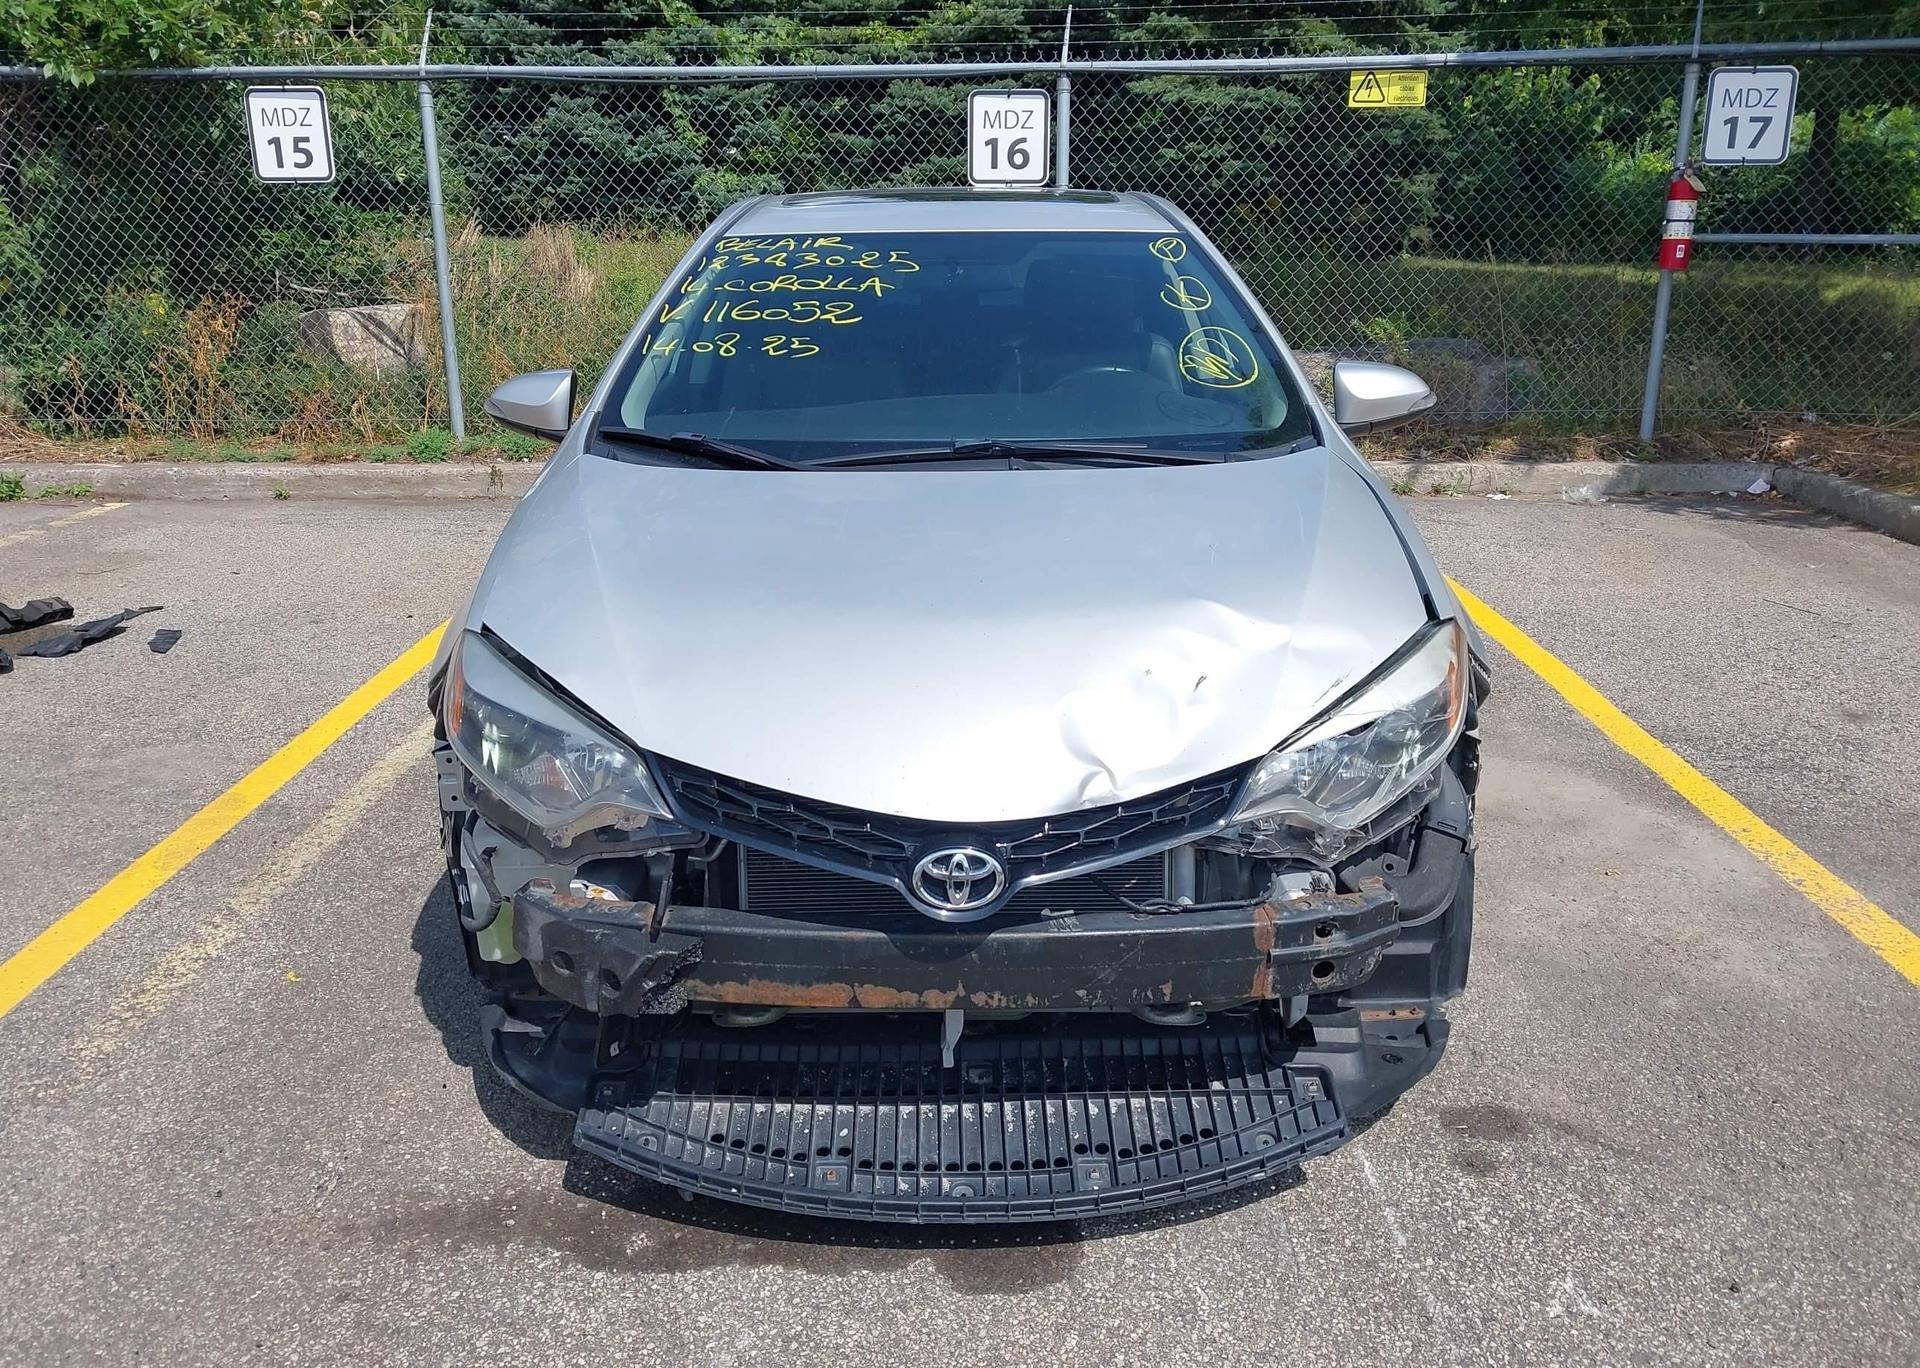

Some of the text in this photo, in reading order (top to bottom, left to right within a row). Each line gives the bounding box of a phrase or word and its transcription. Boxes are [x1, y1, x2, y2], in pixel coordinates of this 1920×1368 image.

[1721, 88, 1780, 108] MDZ
[260, 107, 313, 127] MDZ
[983, 109, 1035, 129] MDZ
[1723, 116, 1774, 149] 17
[266, 136, 314, 169] 15
[984, 137, 1031, 170] 16
[703, 300, 863, 324] 116052
